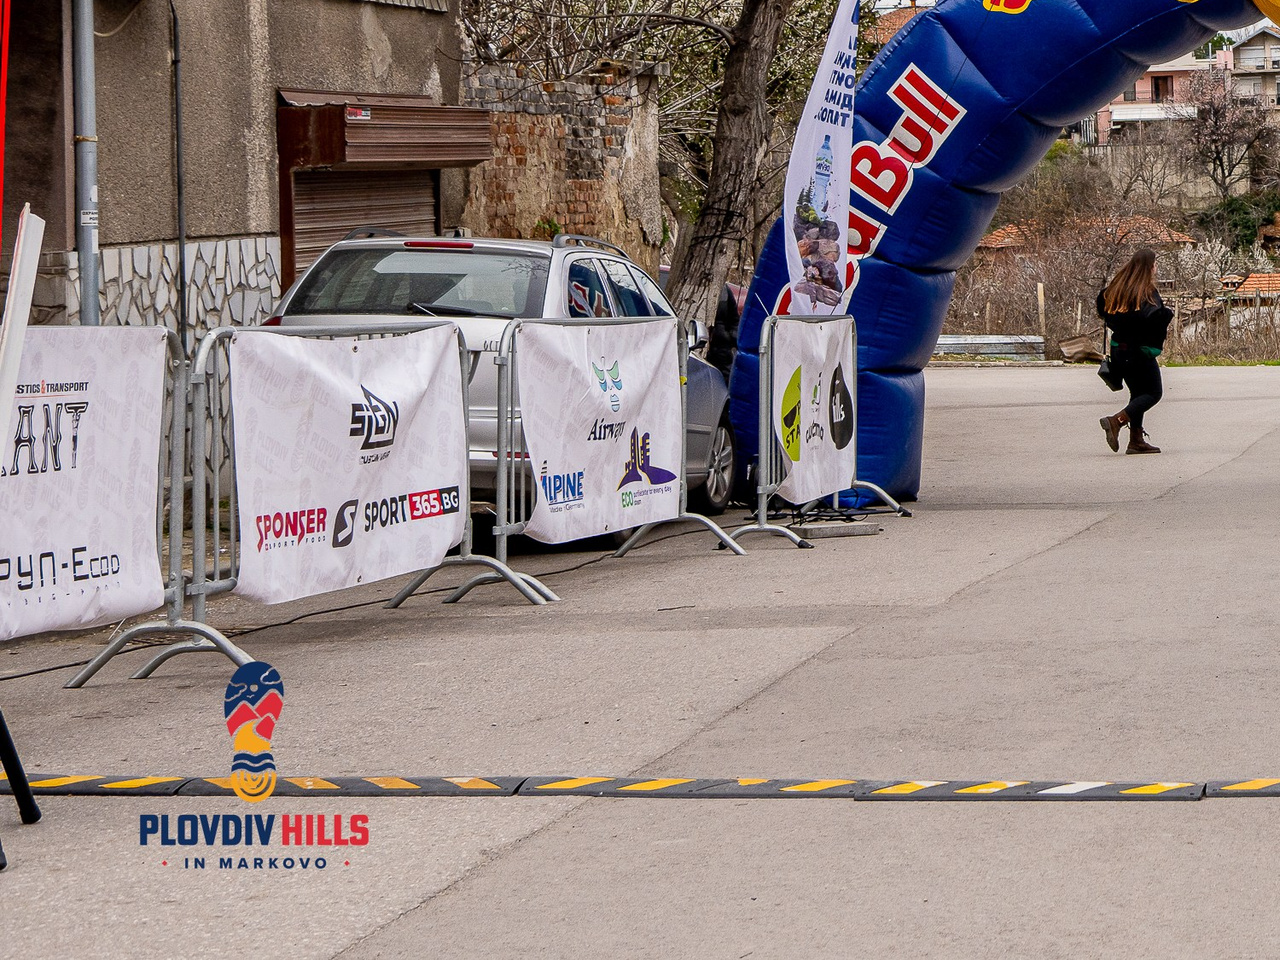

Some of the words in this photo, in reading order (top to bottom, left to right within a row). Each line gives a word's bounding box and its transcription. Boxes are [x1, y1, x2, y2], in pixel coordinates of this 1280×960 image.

[849, 64, 965, 213] Bull
[15, 383, 40, 395] STICS
[46, 381, 89, 393] TRANSPORT
[256, 507, 328, 553] SPONSER
